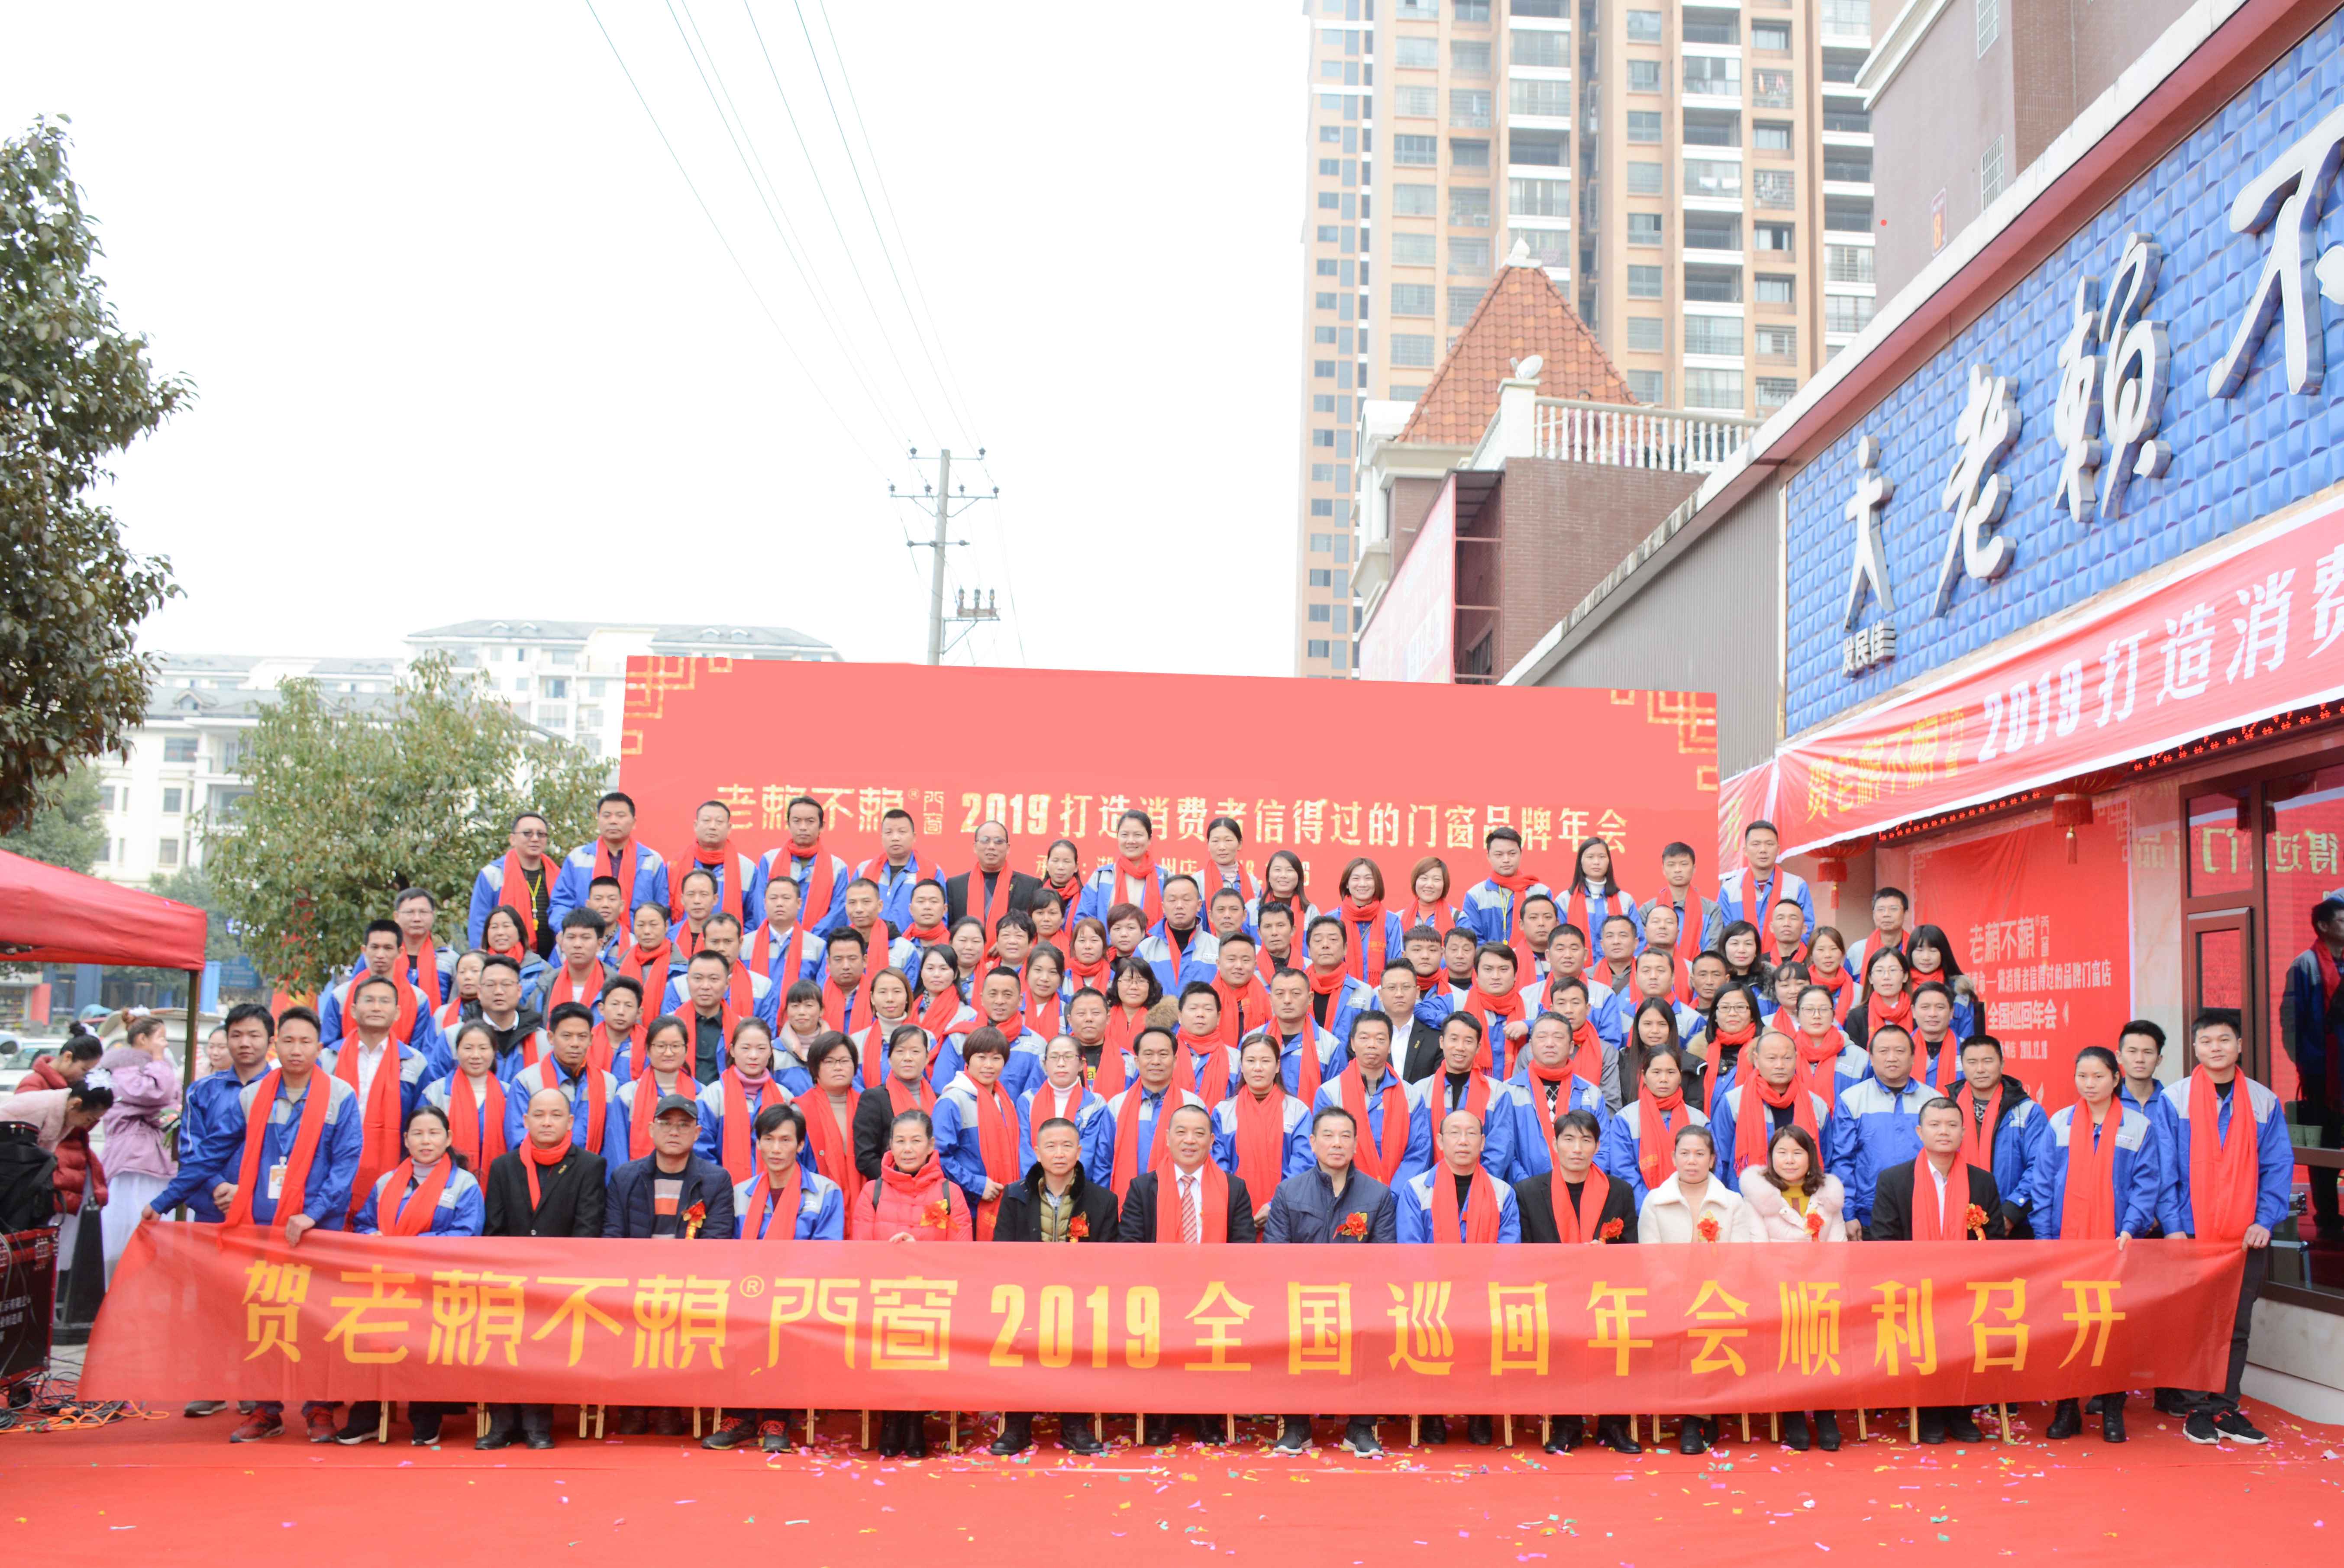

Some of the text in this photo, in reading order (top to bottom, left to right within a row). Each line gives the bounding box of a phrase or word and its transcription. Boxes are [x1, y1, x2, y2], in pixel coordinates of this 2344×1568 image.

[1987, 998, 2057, 1030] 全国巡回年会
